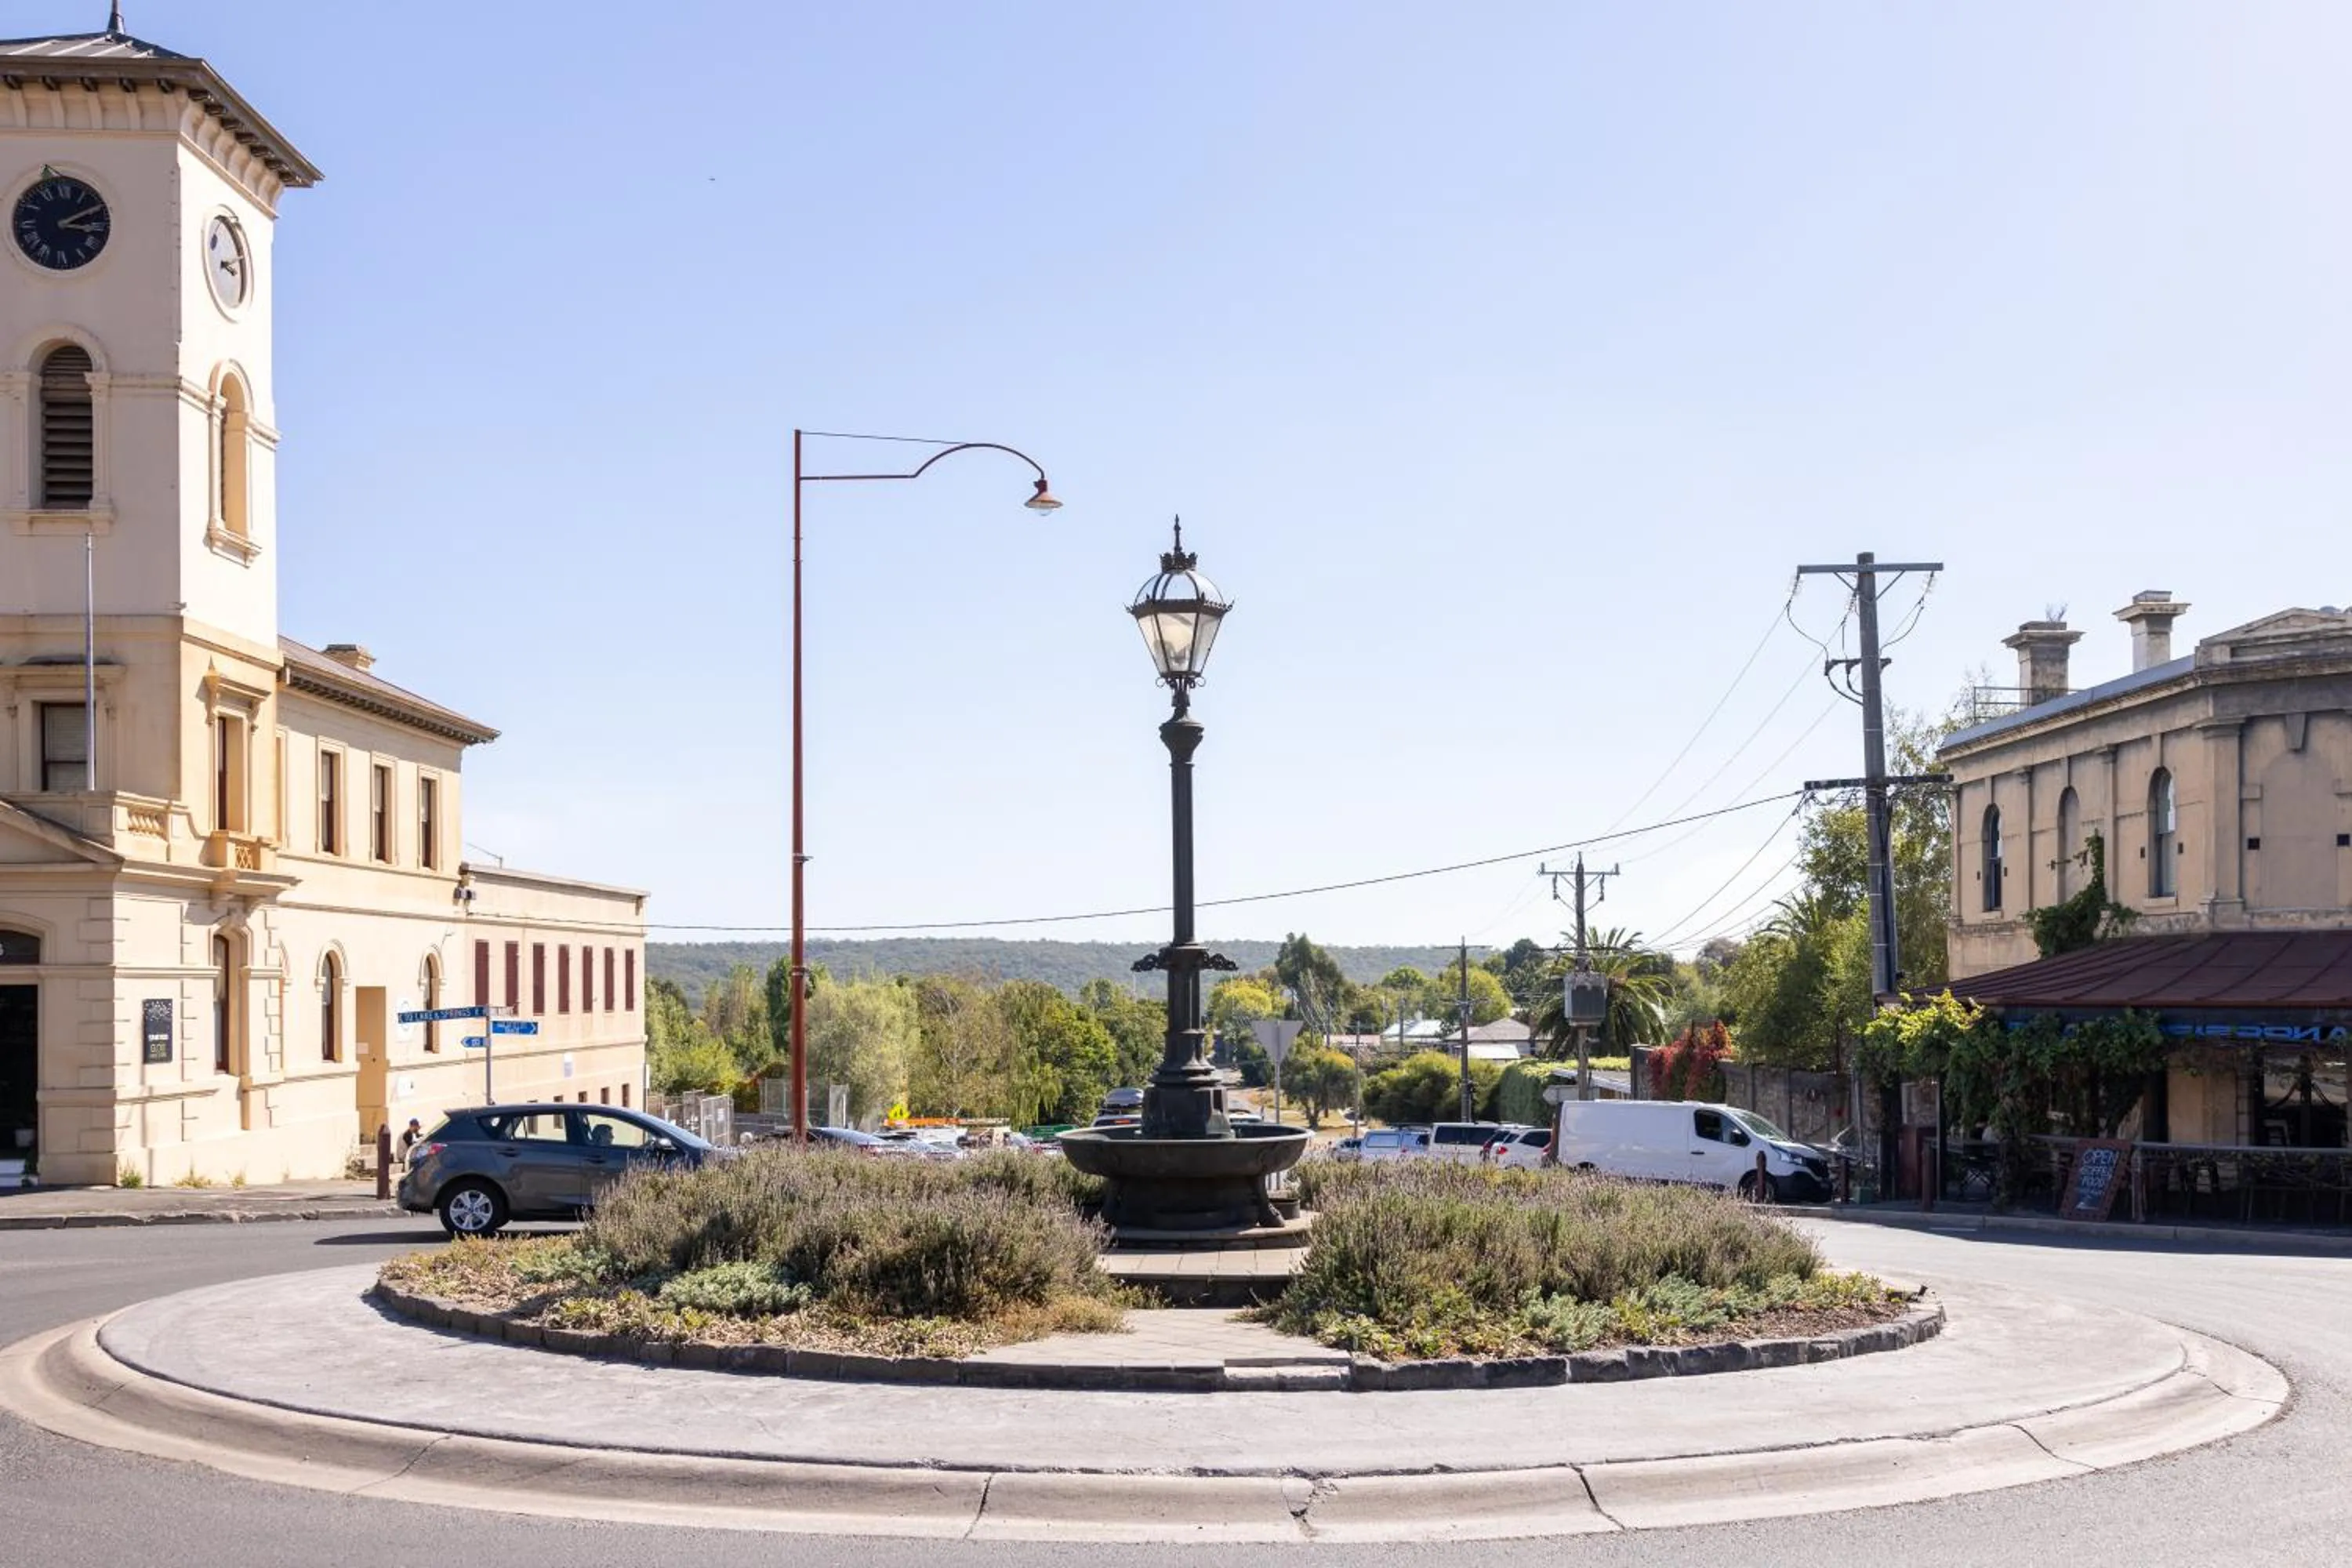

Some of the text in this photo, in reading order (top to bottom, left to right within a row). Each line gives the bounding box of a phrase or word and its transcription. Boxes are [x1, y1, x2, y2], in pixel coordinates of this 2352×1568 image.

[415, 1011, 433, 1022] LAKE
[441, 1008, 470, 1018] SPRINGS
[2083, 1149, 2119, 1167] OPEN
